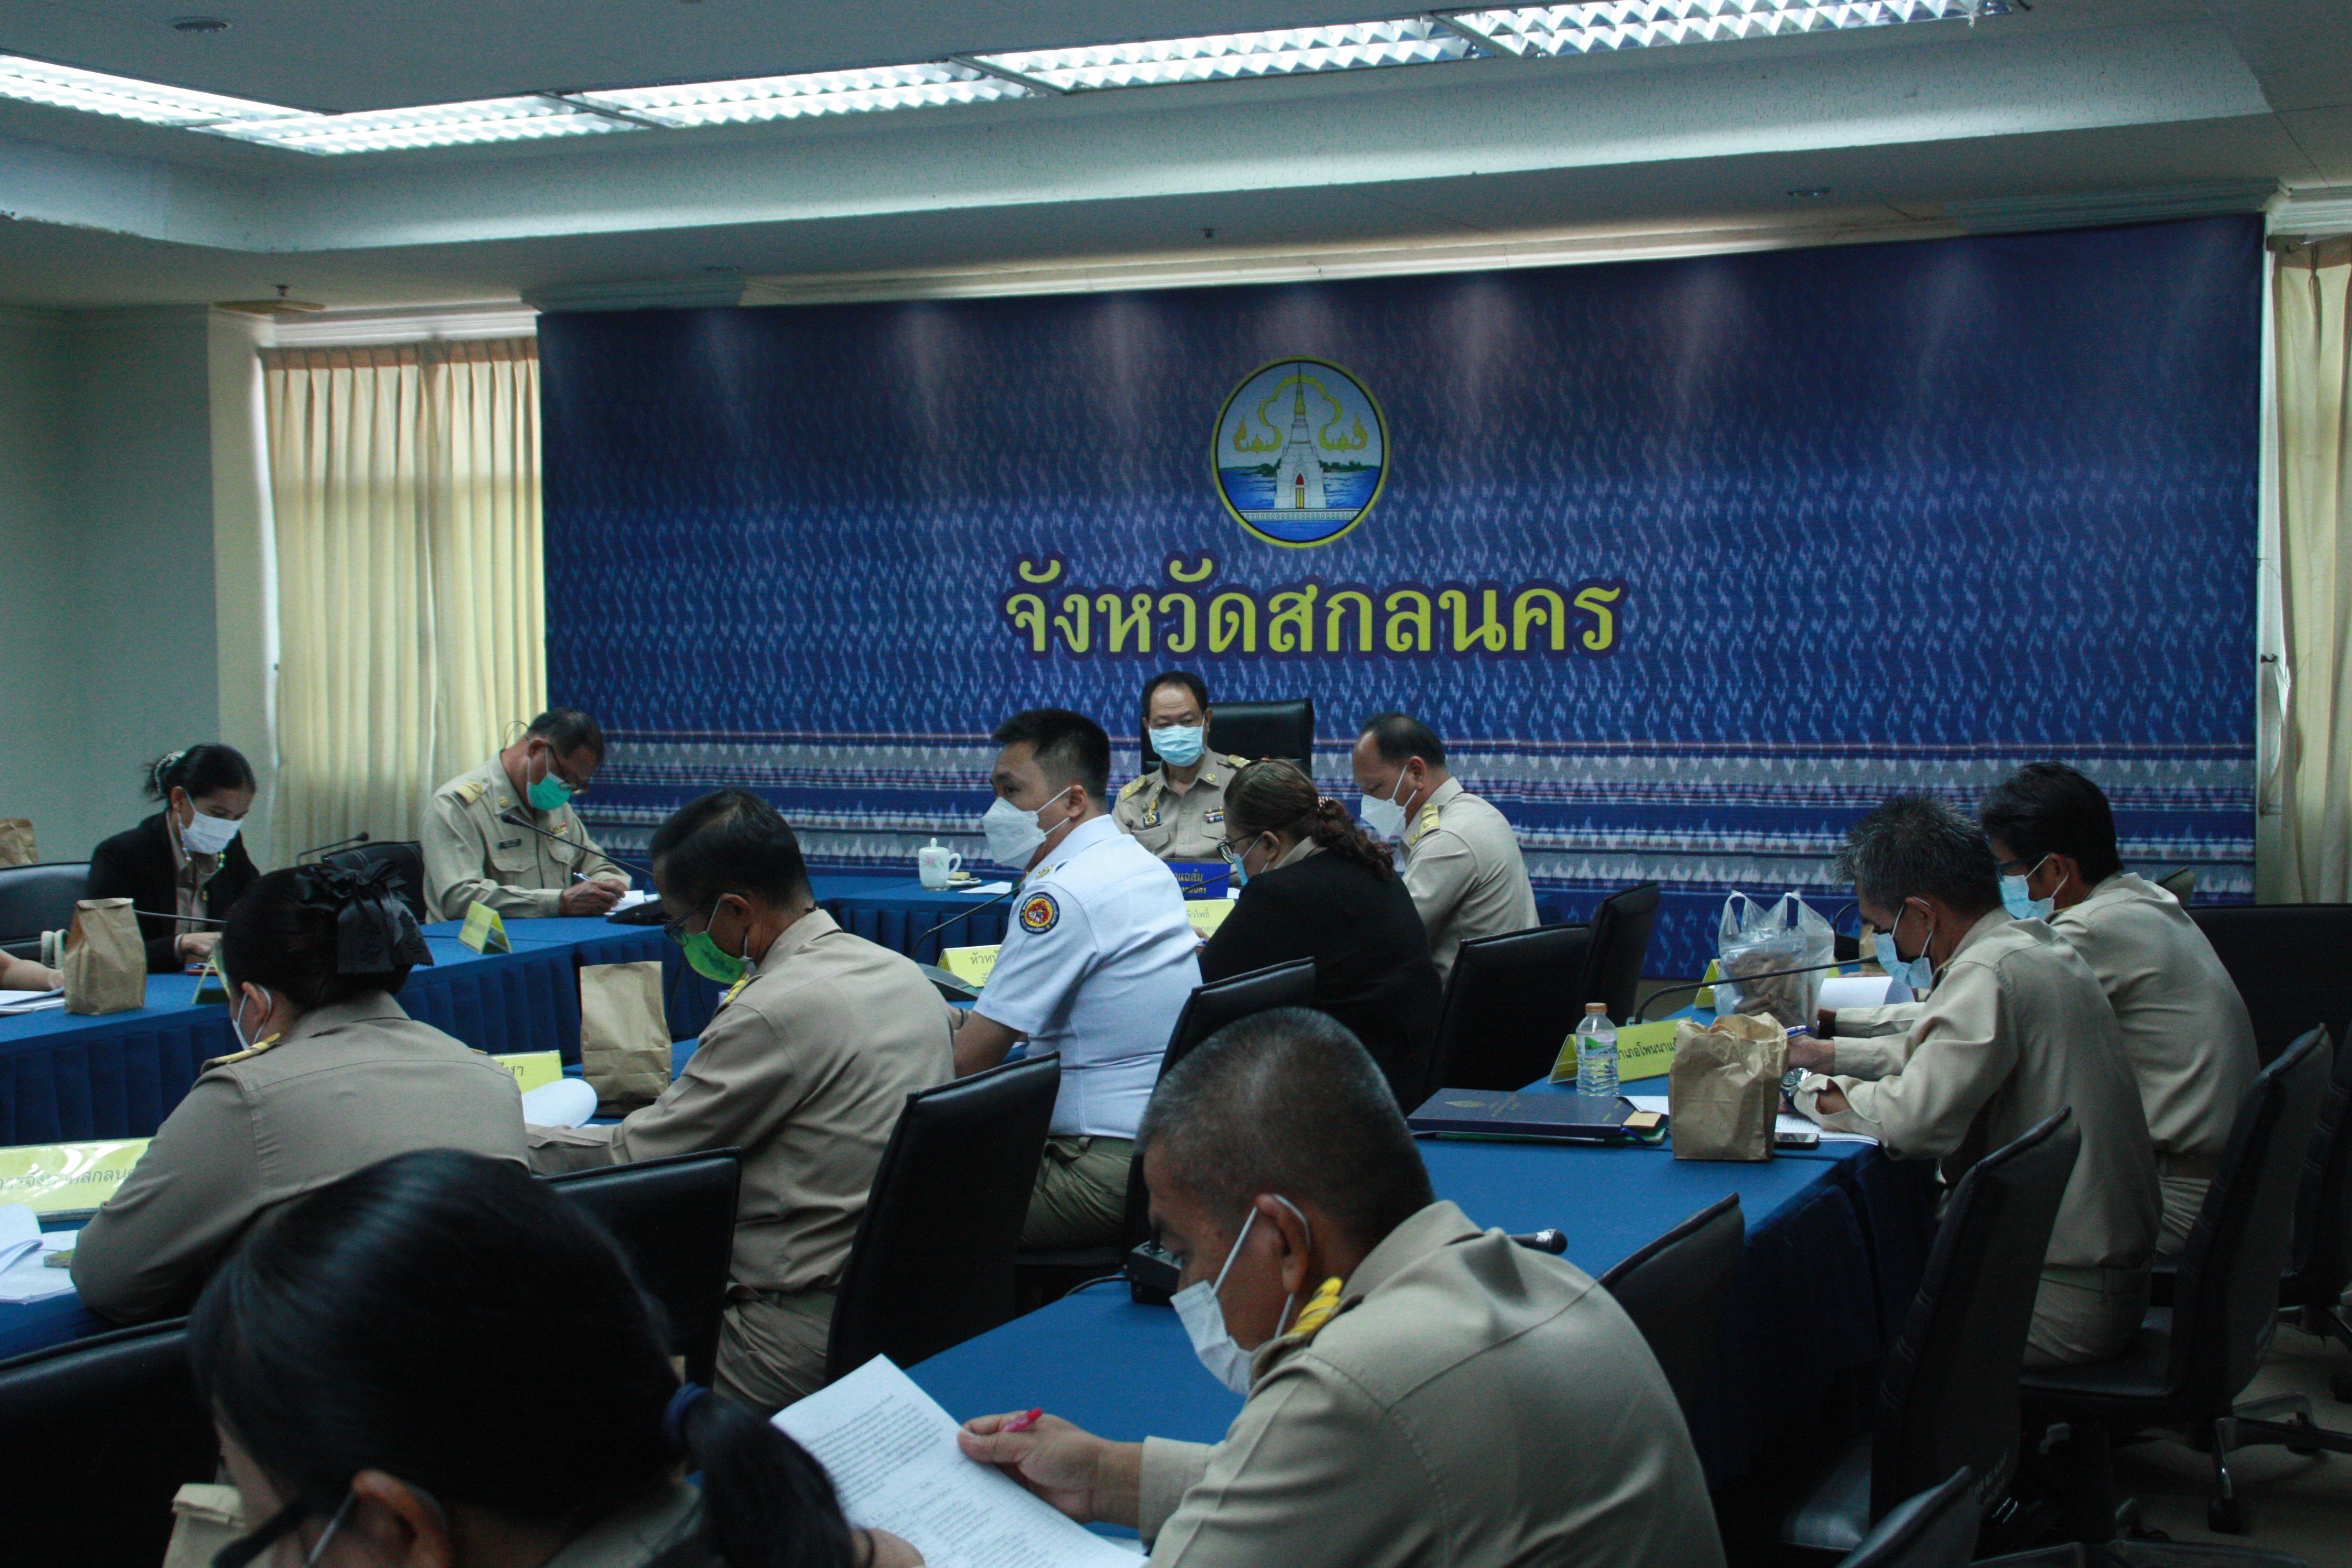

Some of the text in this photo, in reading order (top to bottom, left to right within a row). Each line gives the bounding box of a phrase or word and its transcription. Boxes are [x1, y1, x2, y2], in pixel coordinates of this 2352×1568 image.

[1008, 559, 1620, 652] จังหวัดสกลนคร
